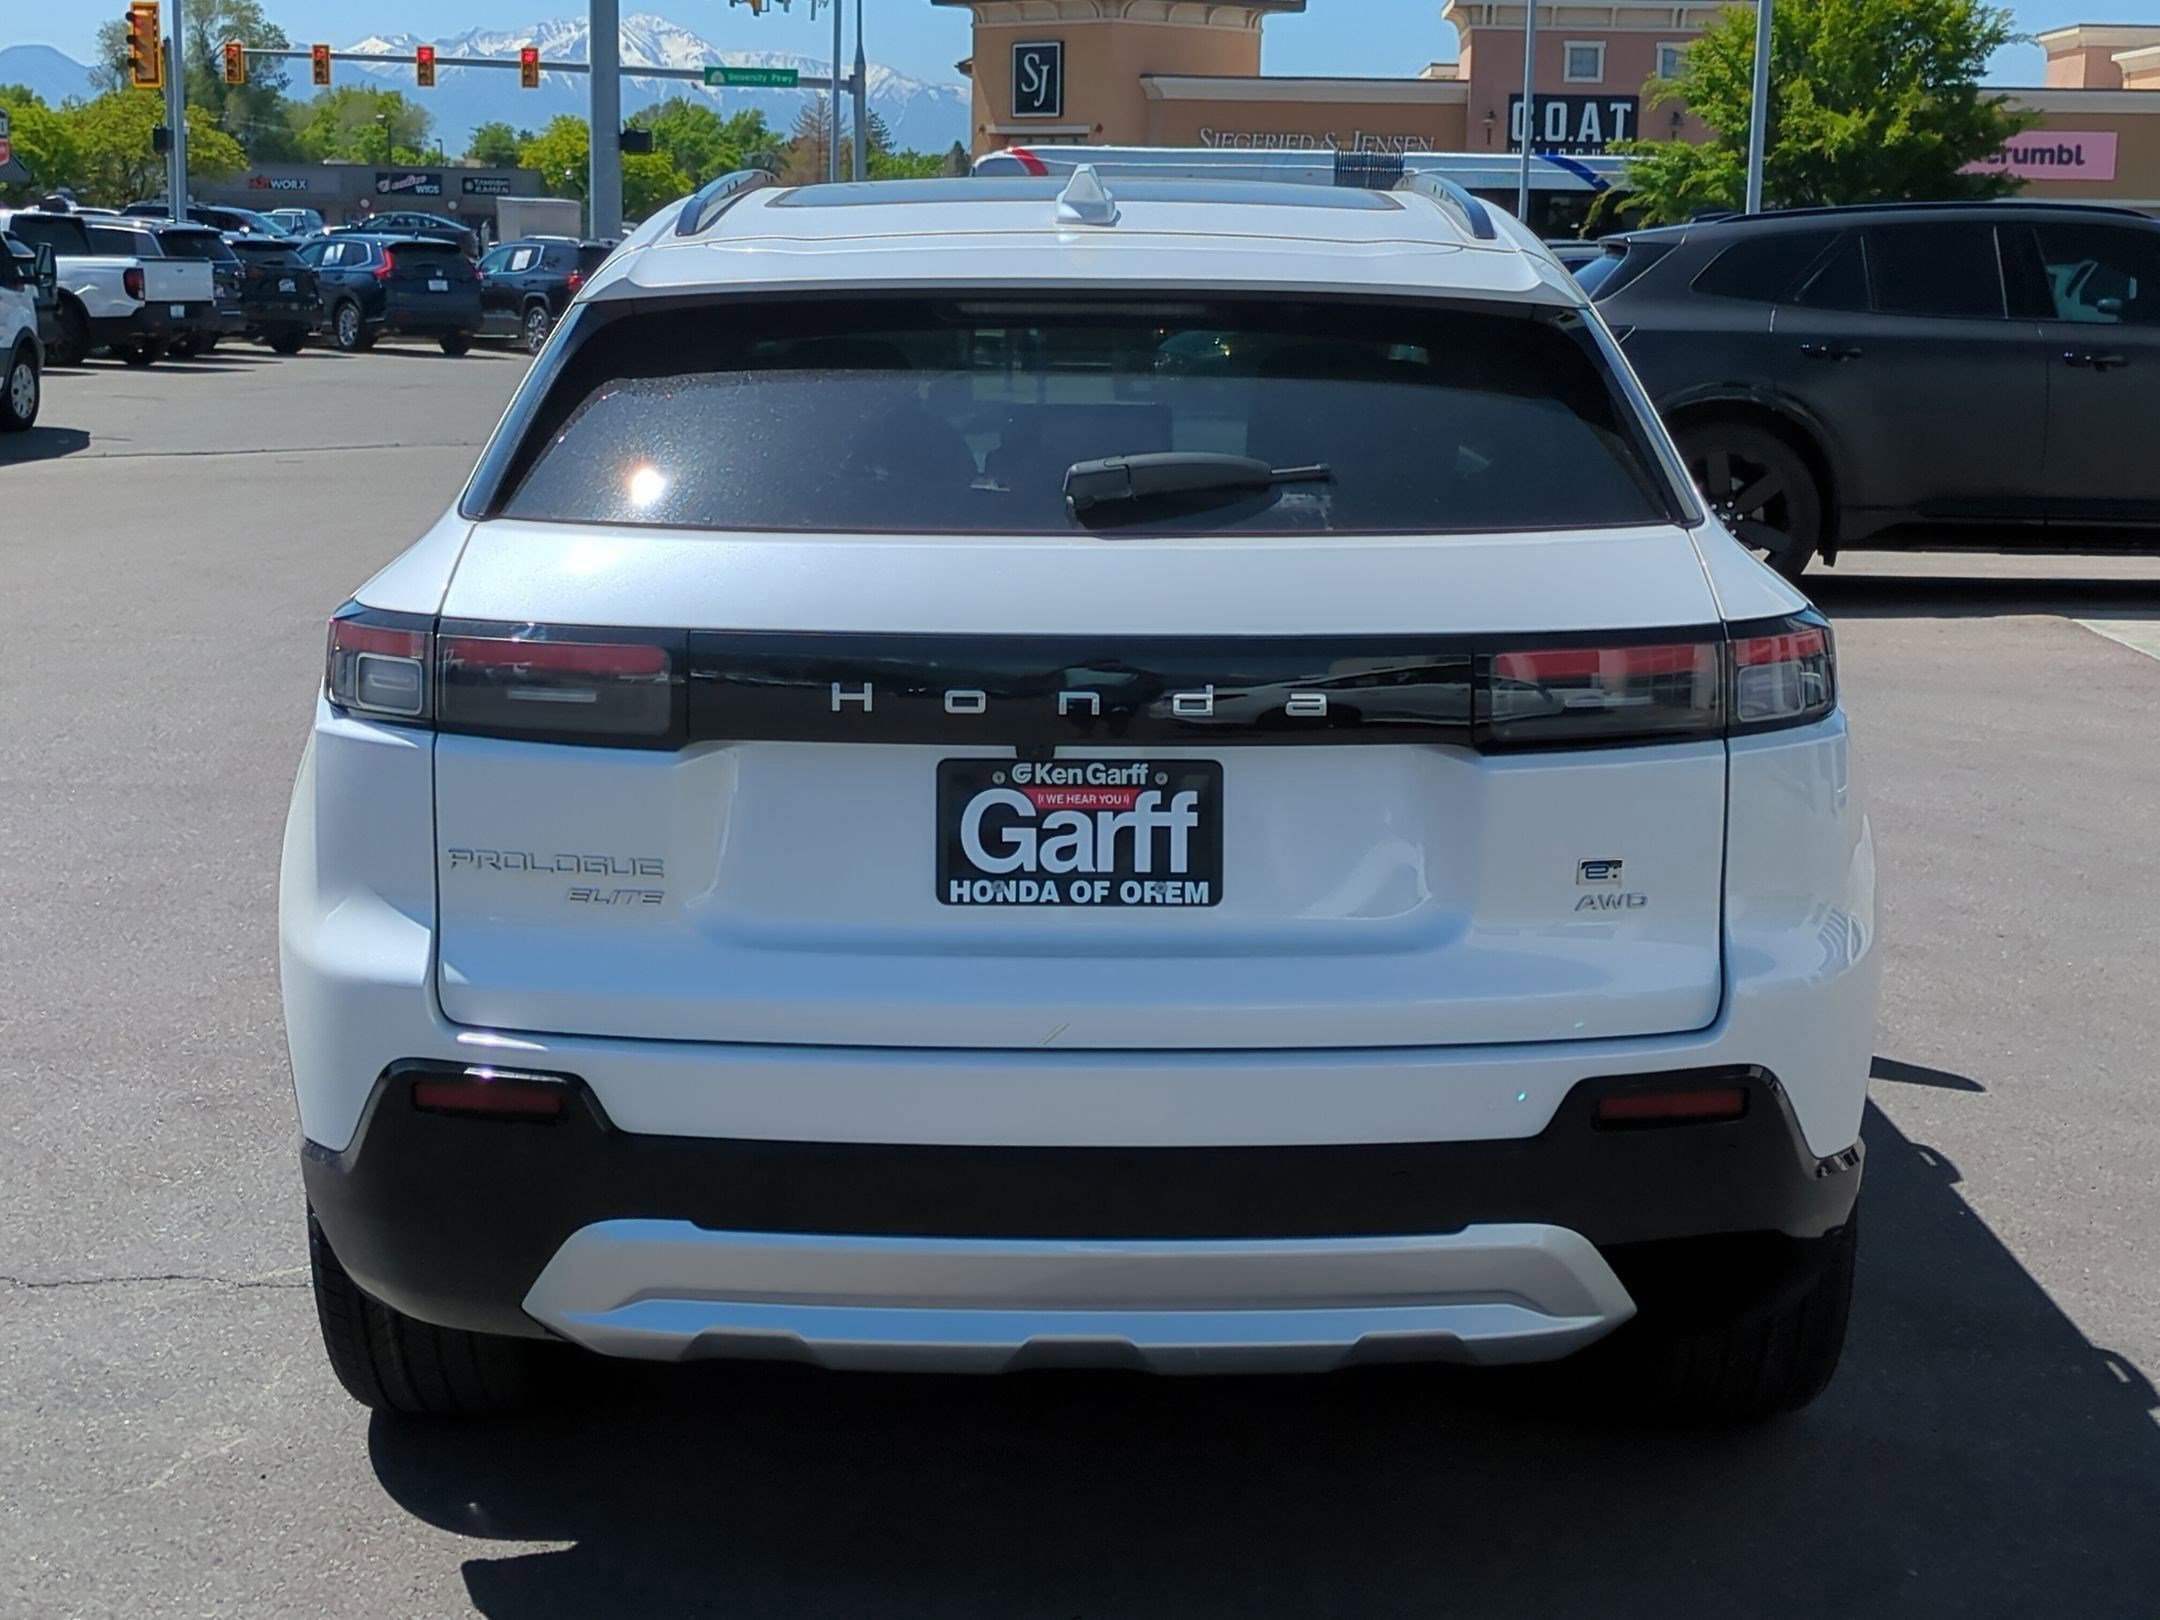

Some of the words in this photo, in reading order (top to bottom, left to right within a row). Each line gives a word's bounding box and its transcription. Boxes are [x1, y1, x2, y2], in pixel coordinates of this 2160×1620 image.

[1020, 52, 1050, 108] SJ
[1320, 131, 1341, 151] &
[831, 682, 1328, 717] Honda
[1035, 763, 1083, 785] Ken
[1086, 763, 1149, 785] Garff
[1046, 794, 1064, 805] WE
[1066, 794, 1097, 805] HEAR
[1099, 794, 1122, 805] YOU
[960, 788, 1199, 874] Garff
[448, 848, 665, 879] PROLOGUE
[568, 887, 665, 905] ELITE
[950, 880, 1060, 904] HONDA
[1069, 880, 1110, 904] OF
[1119, 880, 1209, 904] OREM
[1574, 893, 1648, 912] AWD
